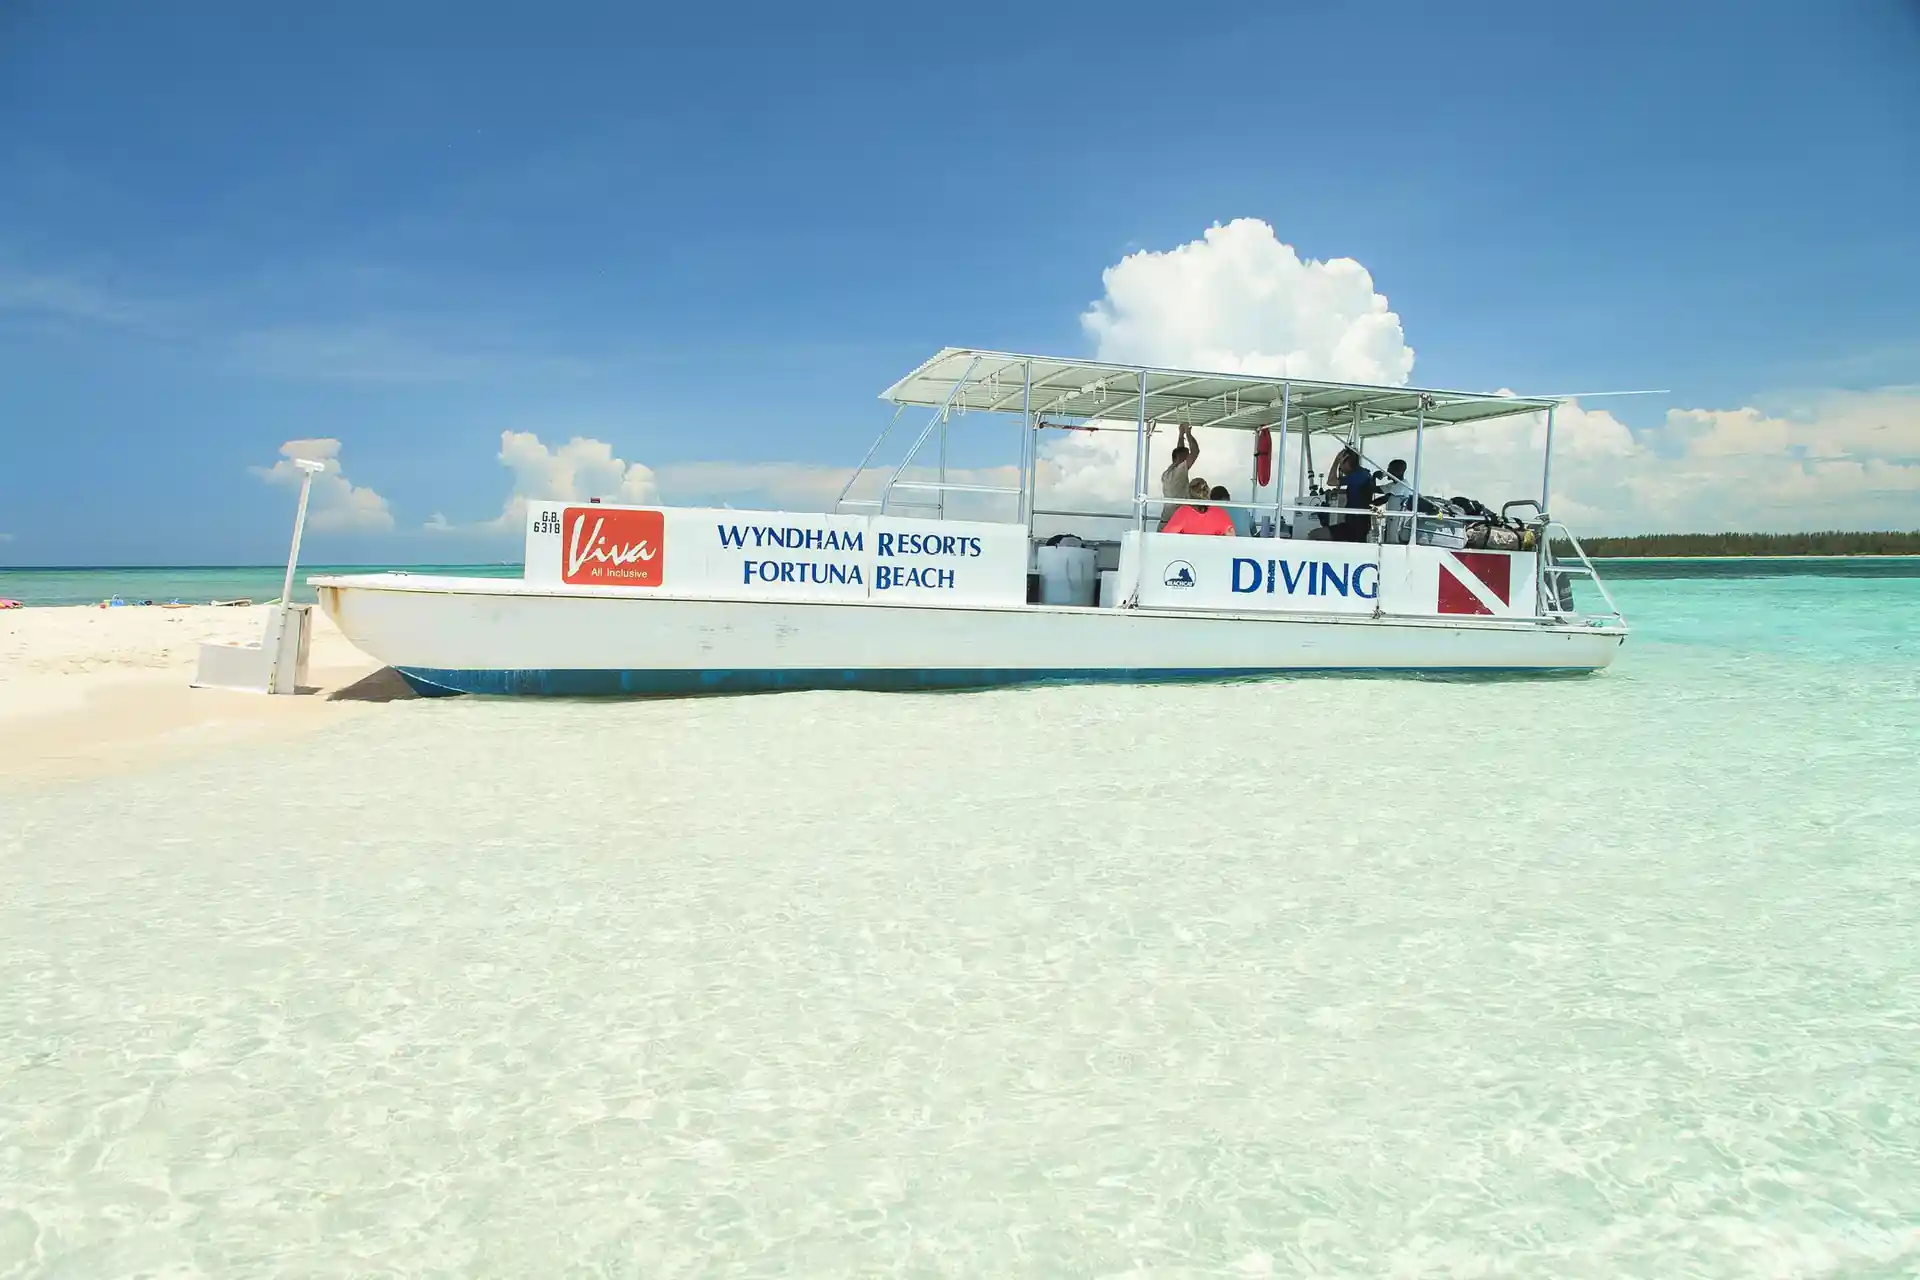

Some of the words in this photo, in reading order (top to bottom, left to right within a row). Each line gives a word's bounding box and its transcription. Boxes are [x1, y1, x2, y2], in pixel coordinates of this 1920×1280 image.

[533, 521, 560, 534] 6318
[542, 511, 560, 523] G.B.
[567, 514, 657, 577] Viva
[718, 524, 863, 552] WYNDHAM
[877, 532, 981, 557] RESORTS
[591, 567, 603, 577] All
[606, 568, 648, 579] Inclusive
[743, 559, 862, 585] FORTUNA
[875, 565, 954, 590] BEACH
[1231, 557, 1378, 599] DIVING
